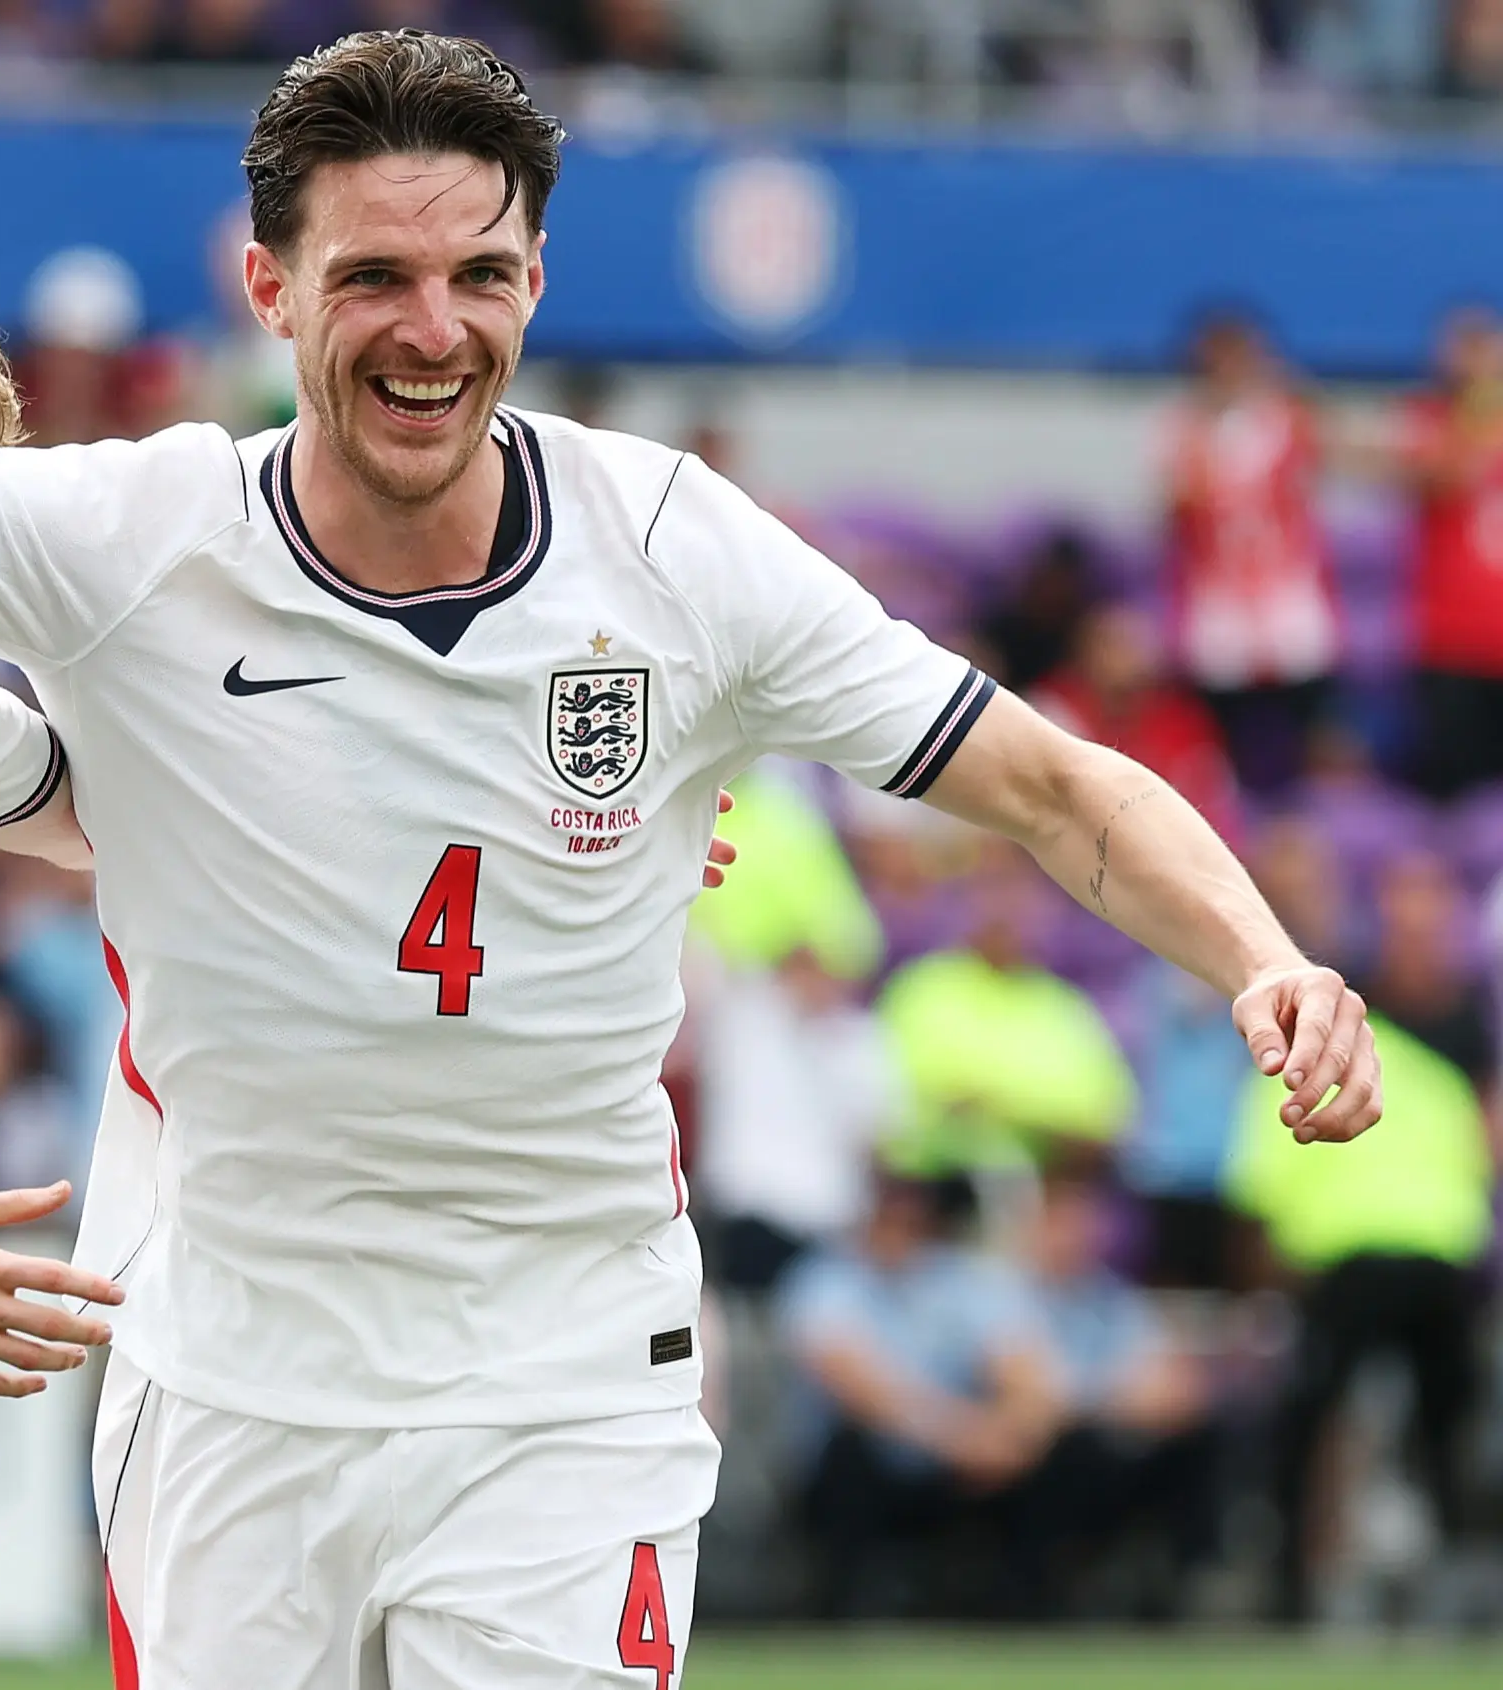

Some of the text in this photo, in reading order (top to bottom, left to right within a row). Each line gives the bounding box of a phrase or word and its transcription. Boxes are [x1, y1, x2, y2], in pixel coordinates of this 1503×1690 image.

[551, 807, 641, 830] COSTA RICA
[397, 843, 484, 1016] 4
[616, 1541, 675, 1690] 4
